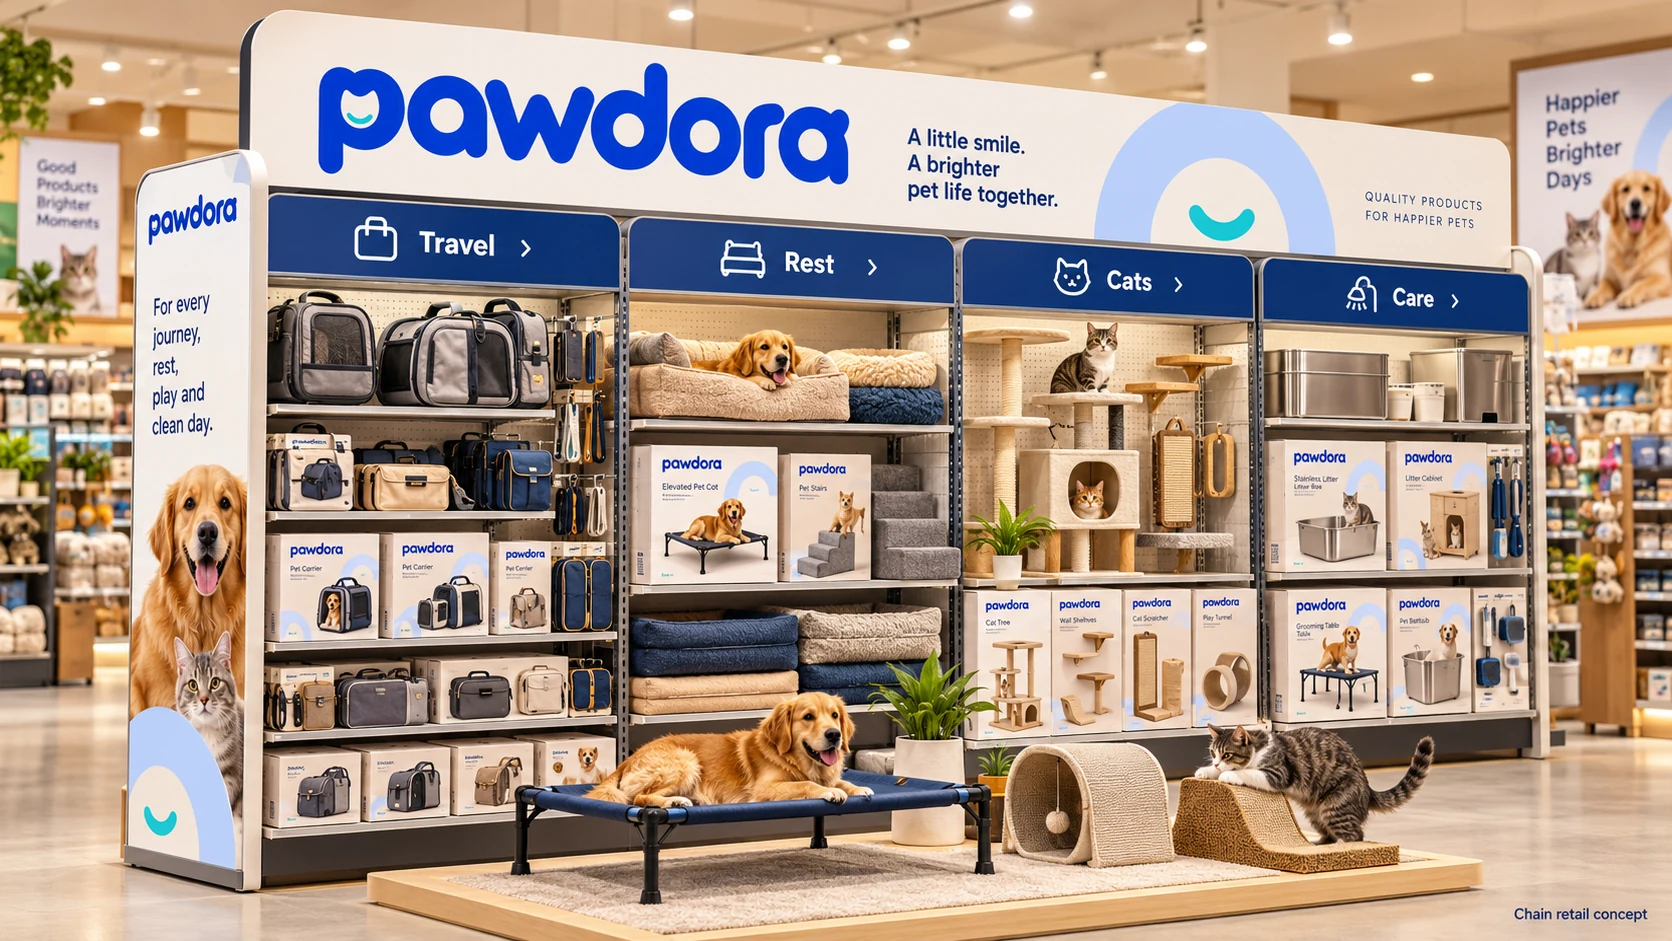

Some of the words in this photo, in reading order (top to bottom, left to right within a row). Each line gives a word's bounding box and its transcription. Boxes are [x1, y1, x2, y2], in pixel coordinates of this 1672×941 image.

[1546, 88, 1621, 114] Happier
[319, 62, 850, 185] pawdora
[1546, 119, 1587, 138] Pets
[907, 127, 922, 146] A
[927, 128, 969, 150] little
[973, 135, 1026, 154] smile.
[1547, 141, 1622, 165] Brighter
[36, 158, 77, 175] Good
[907, 153, 922, 172] A
[927, 154, 1001, 179] brighter
[36, 176, 99, 194] Products
[1547, 171, 1592, 191] Days
[36, 194, 91, 214] Brighter
[907, 182, 939, 202] pet
[944, 181, 973, 201] life
[977, 185, 1059, 209] together.
[1364, 190, 1416, 206] QUALITY
[1421, 195, 1484, 212] PRODUCTS
[36, 213, 101, 231] Moments
[148, 194, 238, 246] pawdora
[1365, 209, 1389, 222] FOR
[1394, 212, 1443, 227] HAPPIER
[1447, 216, 1475, 229] PETS
[419, 230, 496, 258] Travel
[784, 250, 836, 276] Rest
[1107, 268, 1153, 293] Cats
[153, 297, 173, 316] For
[176, 294, 210, 314] every
[1392, 286, 1435, 310] Care
[152, 326, 201, 351] journey,
[152, 356, 179, 377] rest,
[152, 385, 178, 411] play
[181, 380, 205, 403] and
[151, 415, 184, 435] clean
[187, 412, 213, 437] day.
[662, 455, 723, 473] pawdora
[1293, 448, 1347, 467] pawdora
[1405, 449, 1453, 467] pawdora
[799, 462, 847, 477] pawdora
[1405, 474, 1421, 482] Litter
[662, 482, 692, 491] Elevated
[693, 483, 705, 491] Pet
[706, 483, 719, 491] Cot
[290, 542, 344, 559] pawdora
[402, 541, 454, 557] pawdora
[505, 548, 546, 561] pawdora
[985, 599, 1029, 613] pawdora
[1059, 598, 1101, 611] pawdora
[1132, 597, 1172, 610] pawdora
[1202, 596, 1240, 609] pawdora
[1296, 598, 1347, 615] pawdora
[1399, 597, 1441, 611] pawdora
[985, 619, 997, 627] Cat
[998, 619, 1011, 627] Tree
